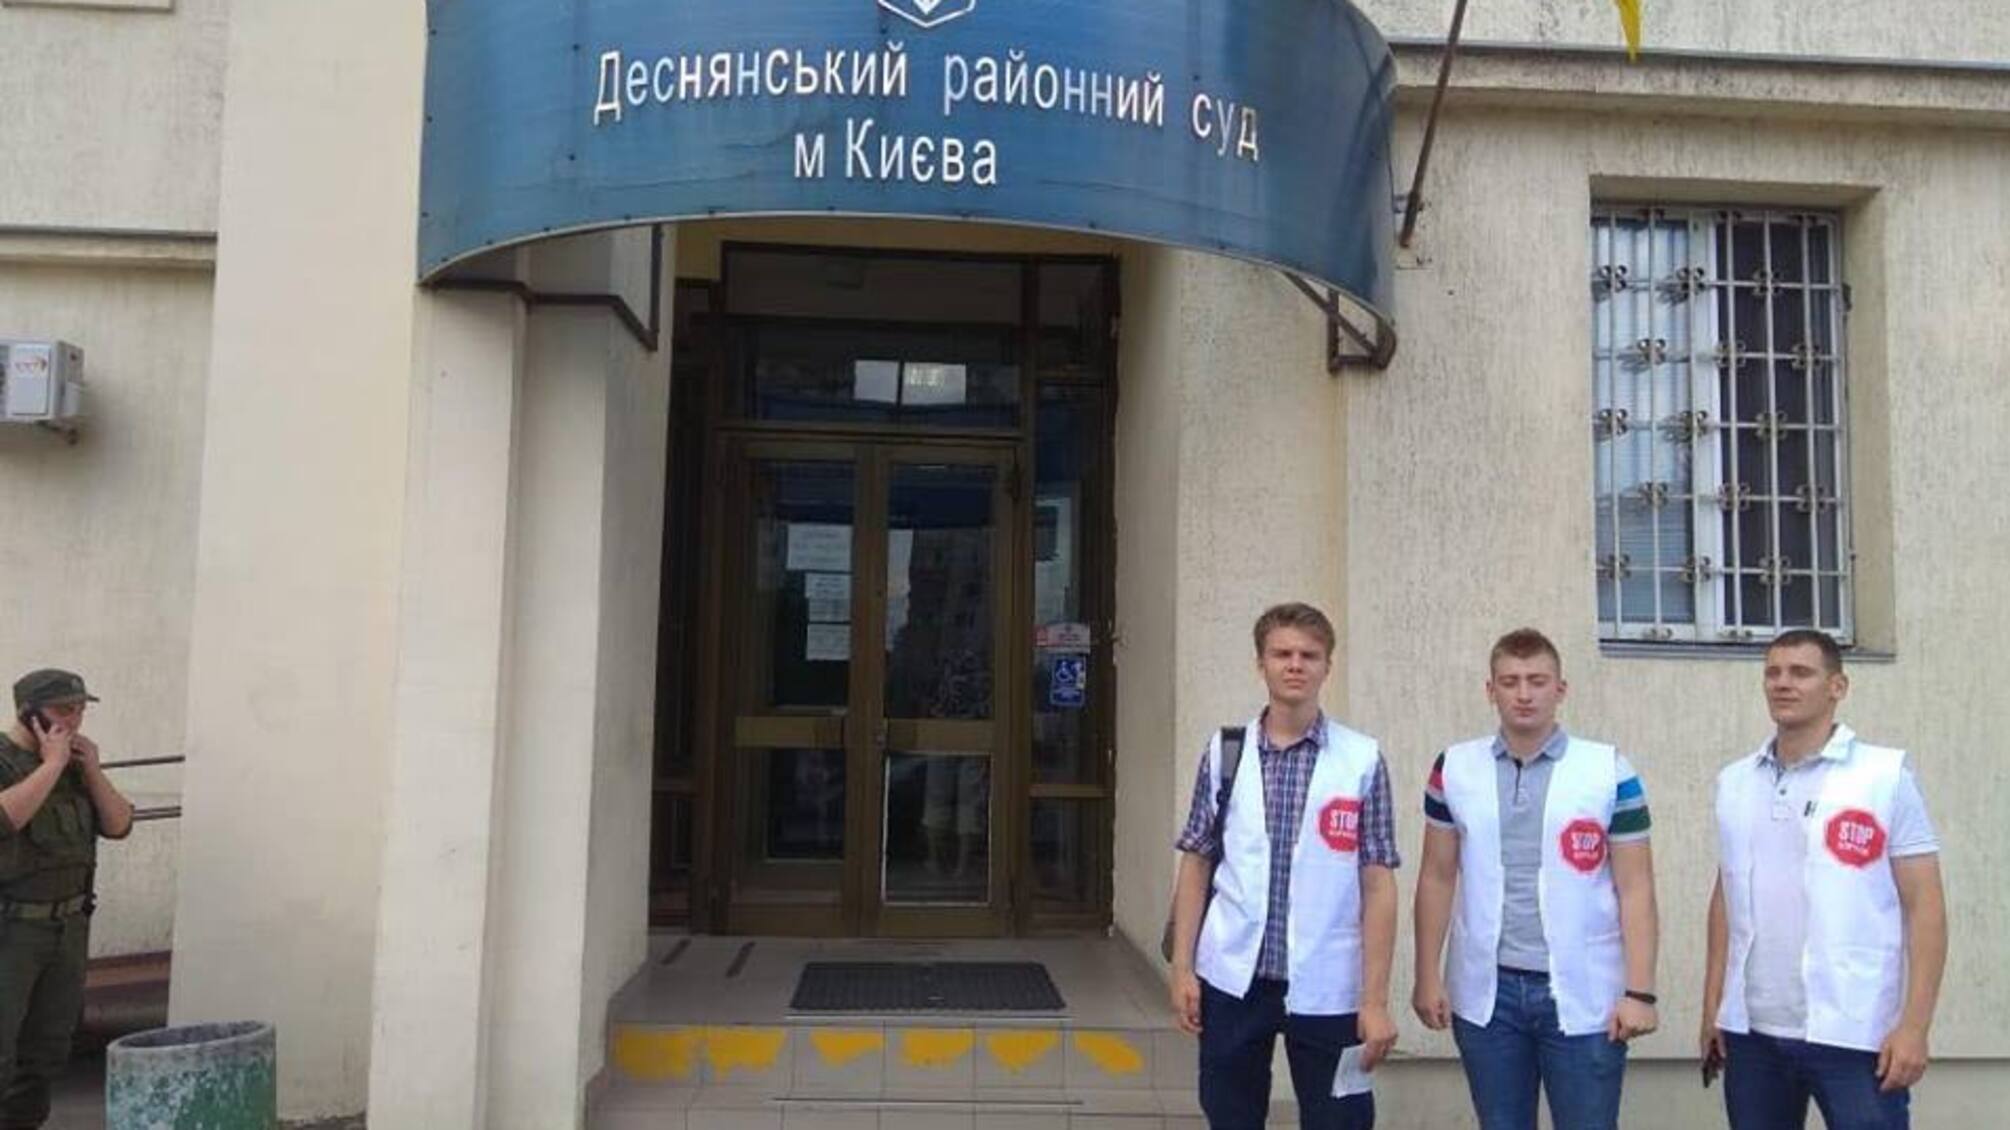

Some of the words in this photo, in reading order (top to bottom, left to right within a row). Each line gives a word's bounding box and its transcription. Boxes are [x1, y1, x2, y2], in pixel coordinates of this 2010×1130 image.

[594, 40, 907, 126] Деснянський
[943, 48, 1165, 127] районний
[1192, 92, 1259, 162] суд
[794, 133, 825, 179] м
[845, 117, 998, 185] Києва
[1570, 831, 1601, 851] STOP
[1839, 820, 1875, 847] STOP
